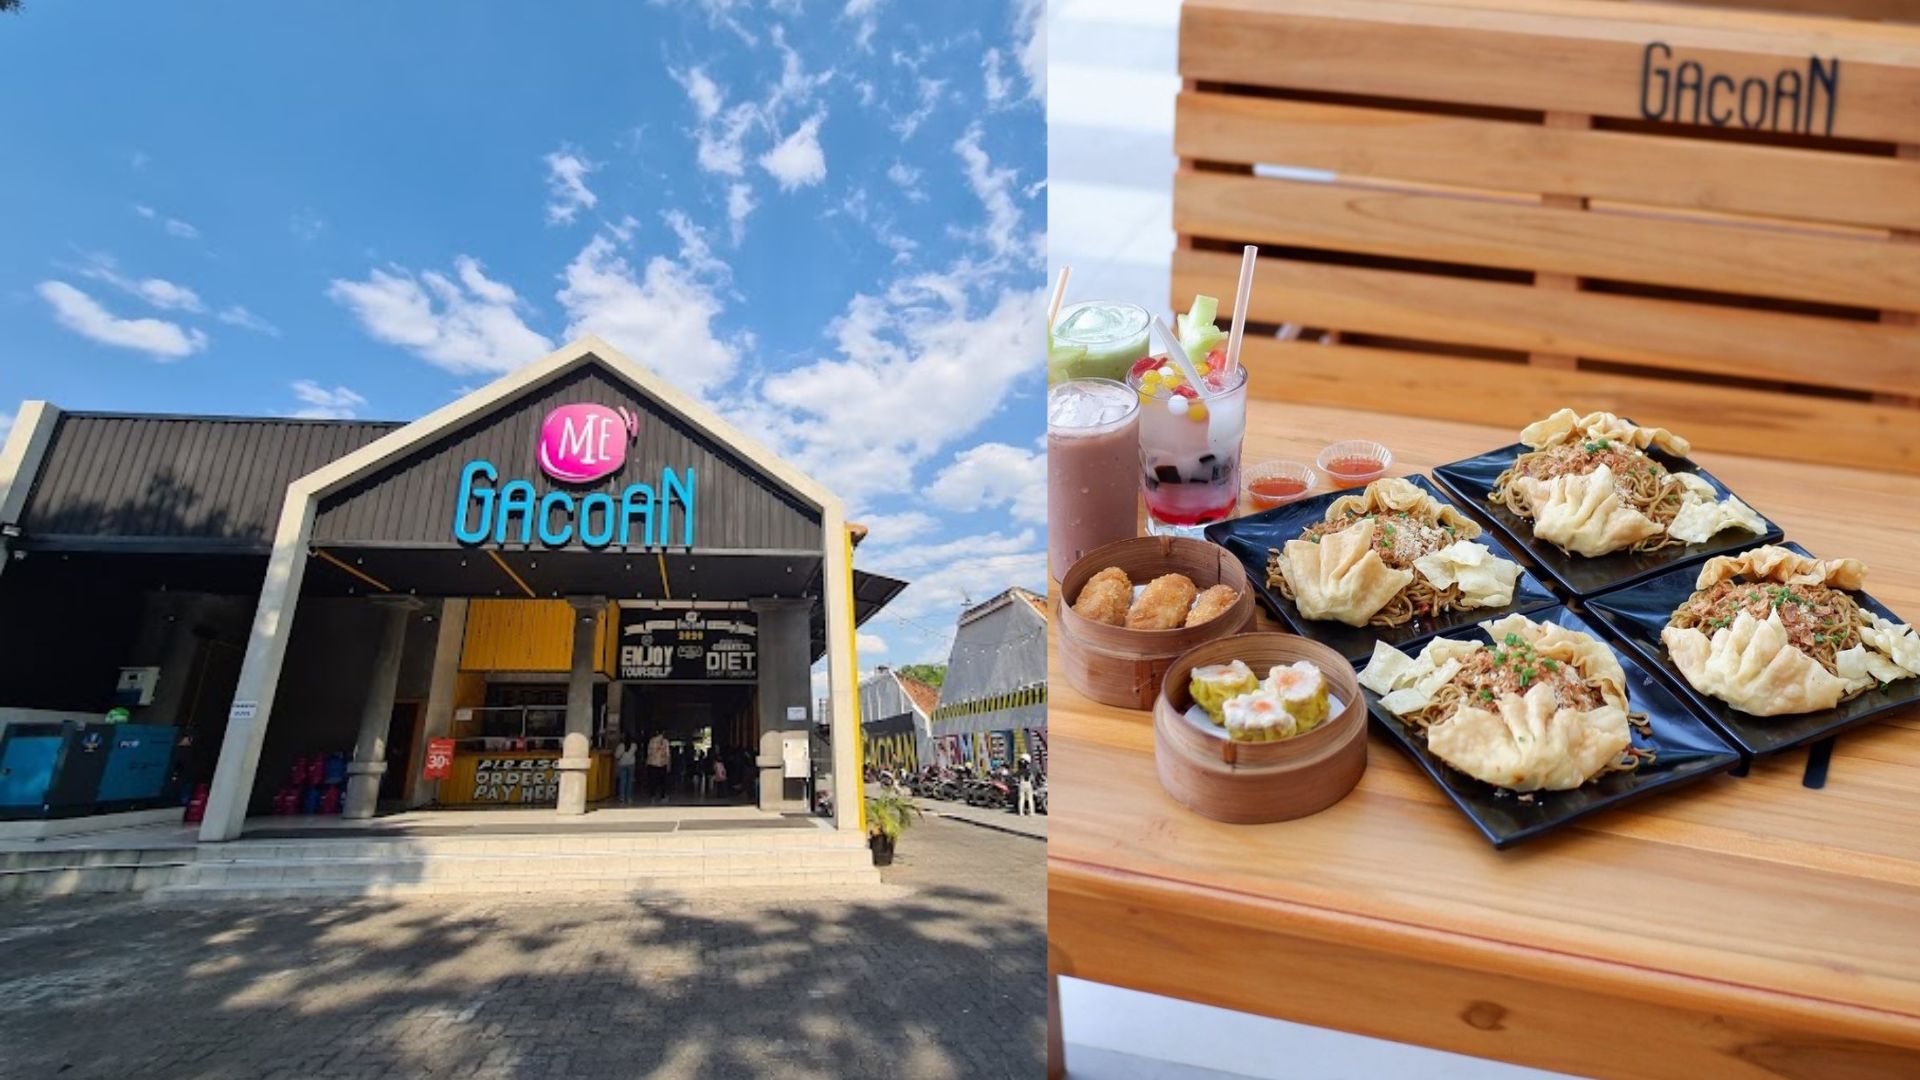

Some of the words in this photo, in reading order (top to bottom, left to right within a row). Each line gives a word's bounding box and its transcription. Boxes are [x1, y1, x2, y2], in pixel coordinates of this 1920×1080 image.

[454, 459, 695, 548] GACOAN
[621, 645, 674, 666] ENJOY
[706, 652, 757, 671] DIET
[476, 771, 545, 785] ORDER
[474, 785, 515, 800] PAY
[522, 784, 558, 802] HER
